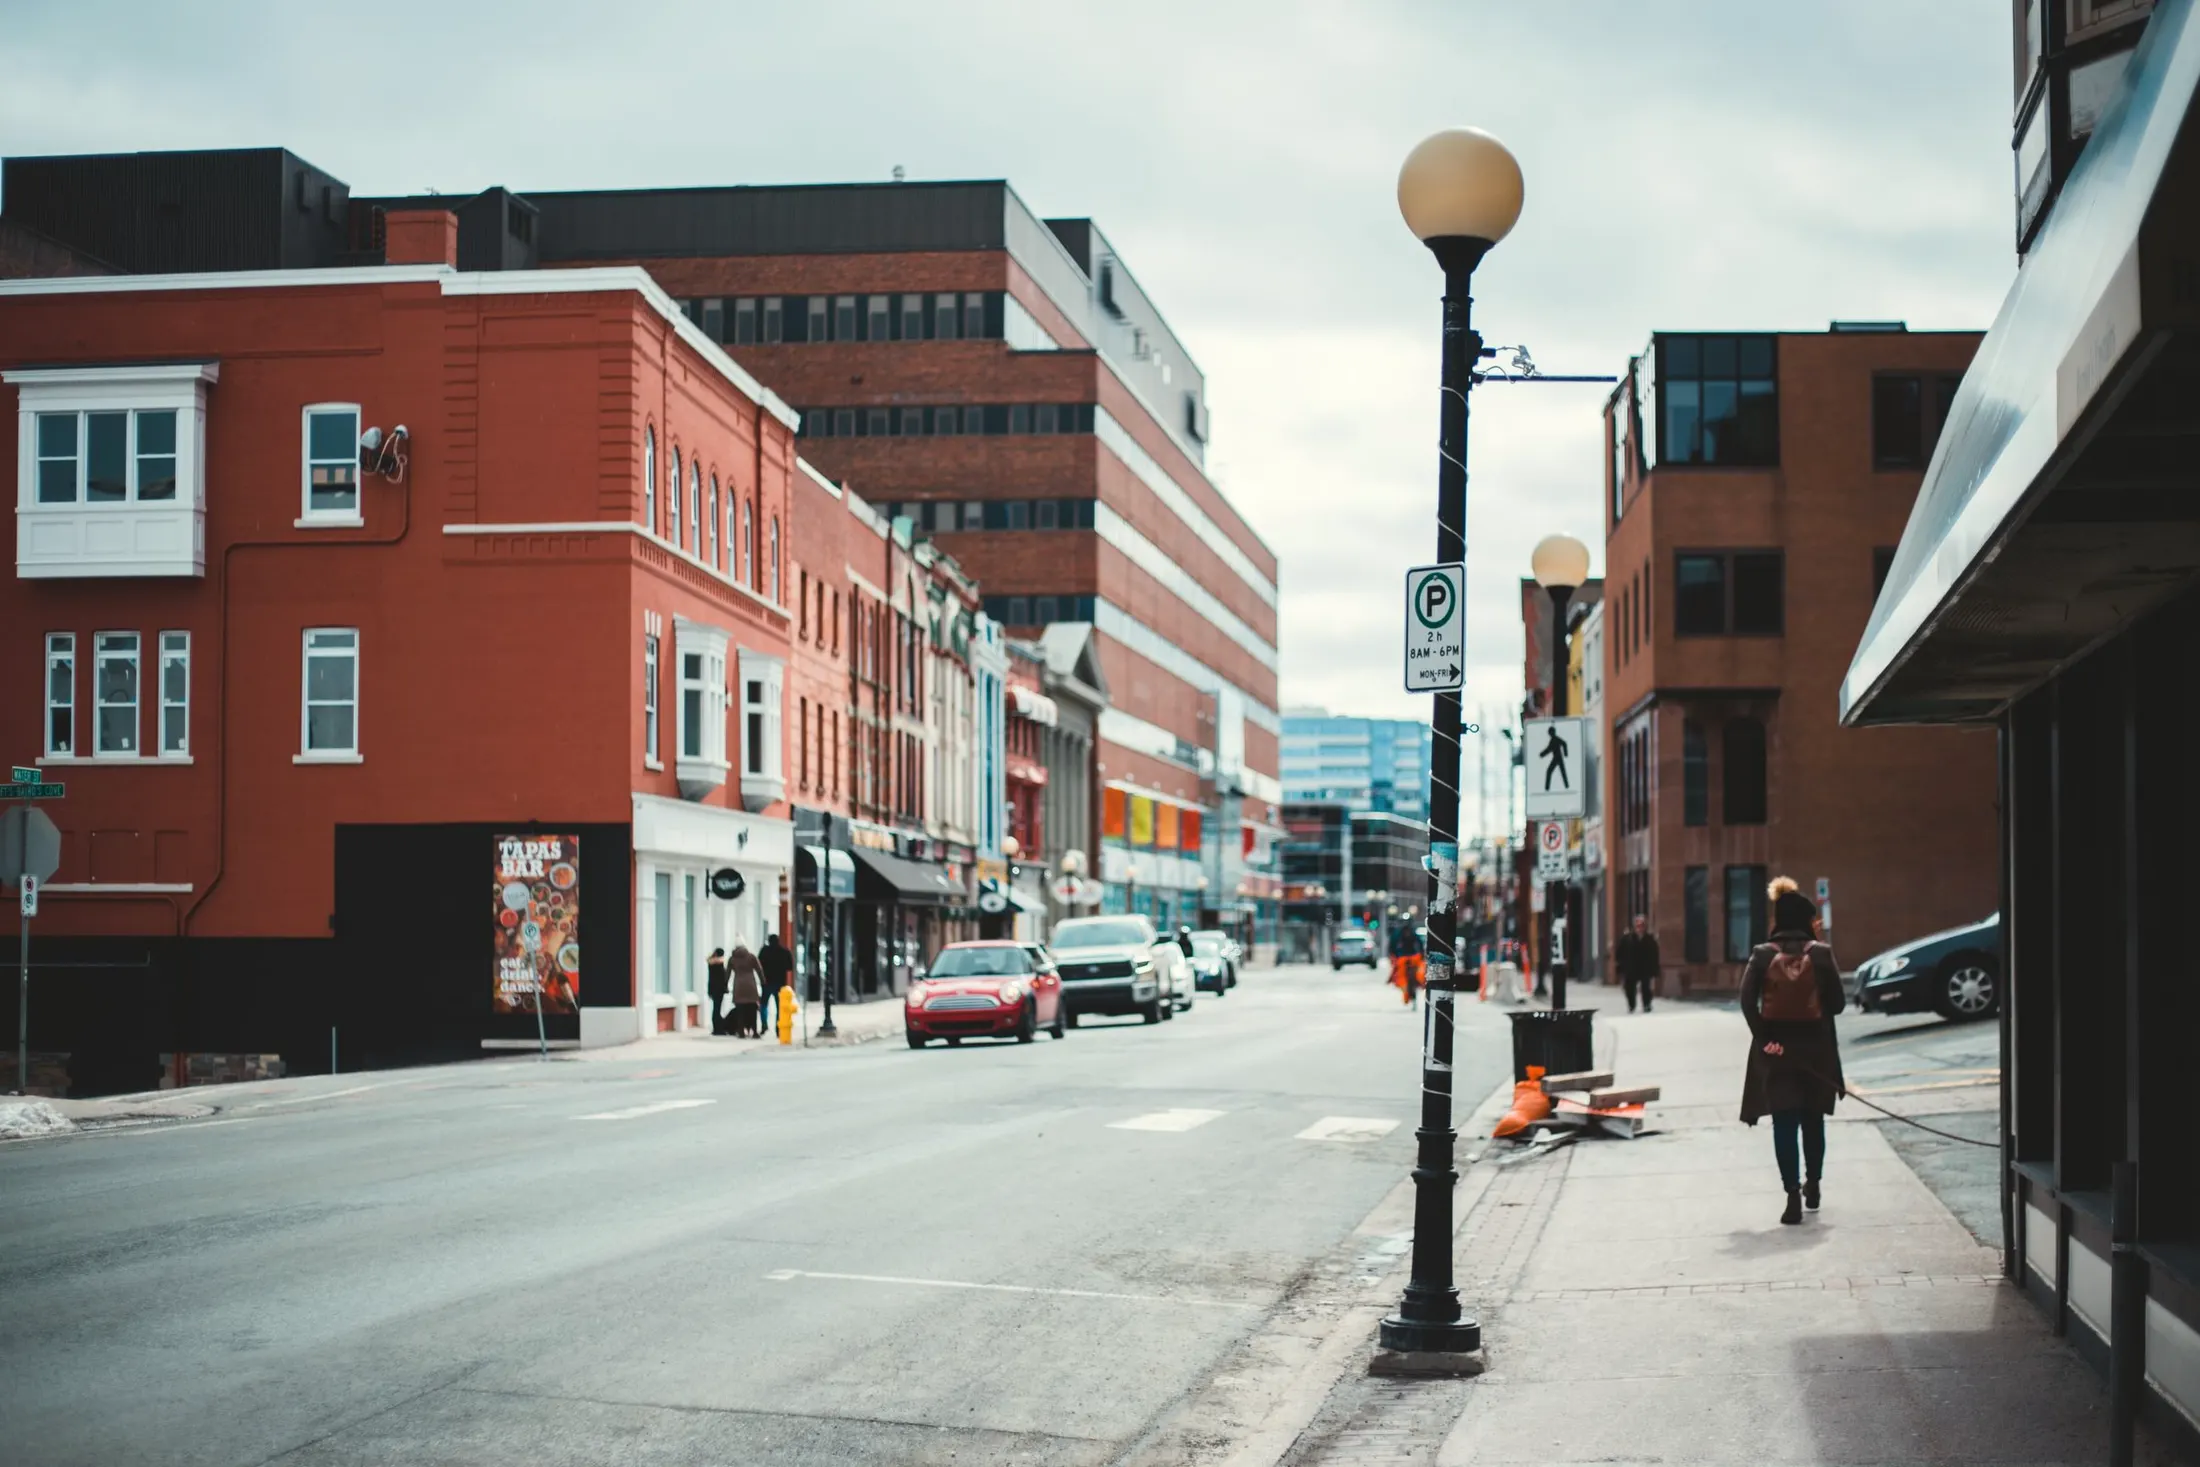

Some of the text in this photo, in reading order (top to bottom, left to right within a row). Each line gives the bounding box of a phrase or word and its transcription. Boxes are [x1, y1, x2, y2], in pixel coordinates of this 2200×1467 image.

[1427, 585, 1446, 617] P
[1428, 631, 1443, 642] 2 h
[1410, 647, 1430, 659] 8AM
[1440, 645, 1459, 657] 6PM
[1420, 668, 1449, 679] MON-FRI
[14, 769, 31, 782] WATER
[45, 785, 62, 796] COVE
[499, 841, 561, 860] TAPAS
[501, 859, 545, 878] BAR
